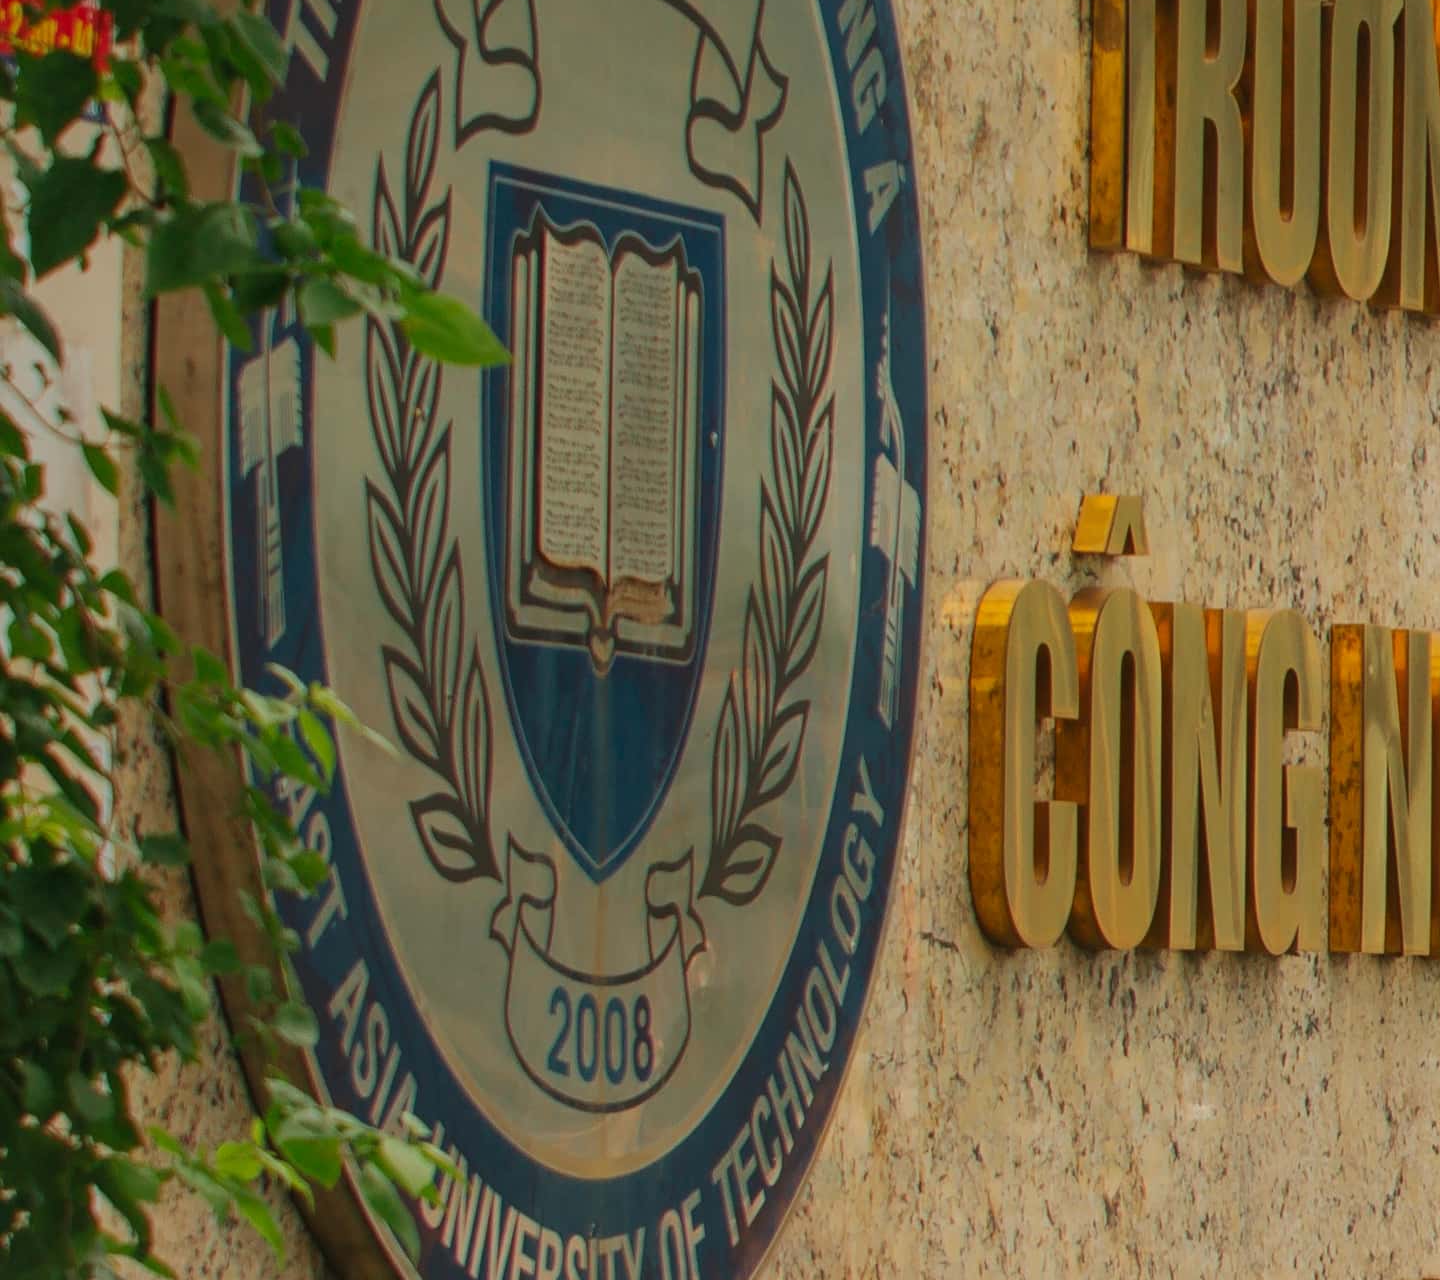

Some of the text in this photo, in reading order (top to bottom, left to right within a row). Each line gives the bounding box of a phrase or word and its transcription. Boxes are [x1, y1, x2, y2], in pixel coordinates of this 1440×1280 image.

[969, 493, 1325, 956] CÔNG
[328, 956, 420, 1140] ASIA
[711, 754, 886, 1250] TECHNOLOGY
[546, 985, 656, 1087] 2008
